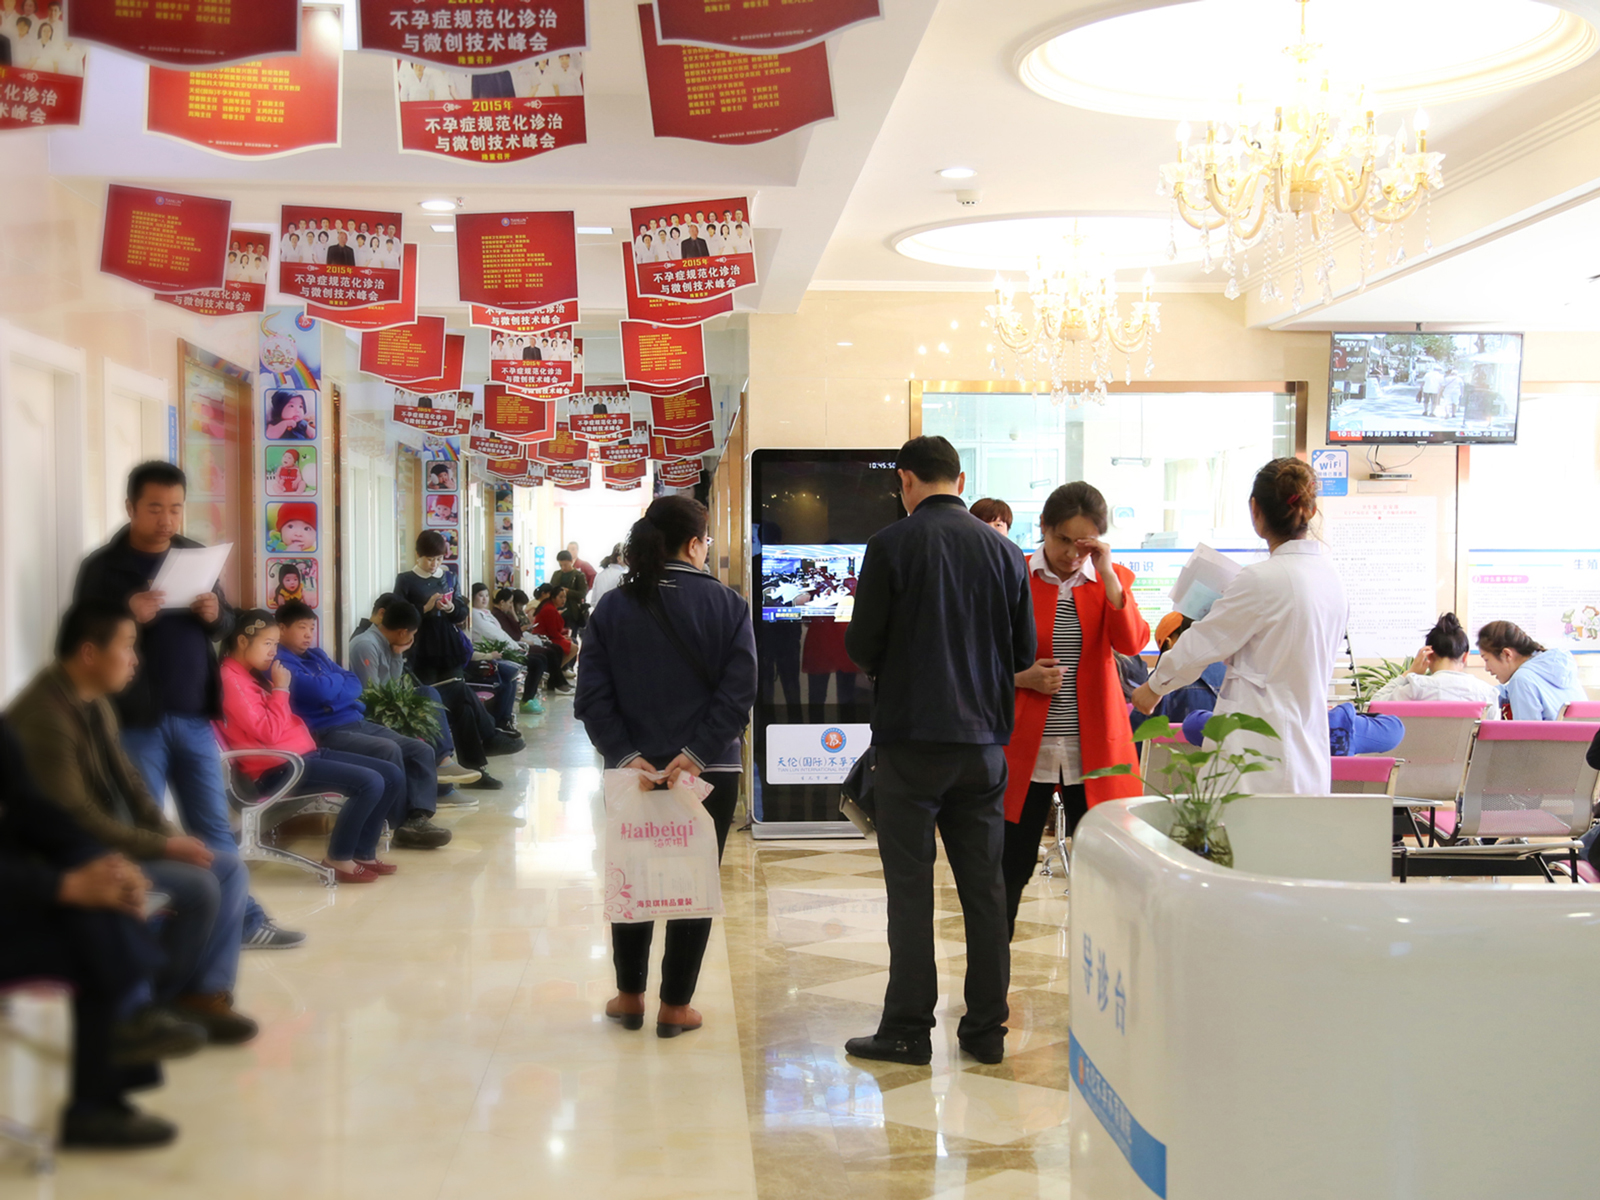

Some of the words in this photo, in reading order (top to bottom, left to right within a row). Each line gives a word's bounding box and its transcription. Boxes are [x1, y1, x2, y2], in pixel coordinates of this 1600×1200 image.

[389, 9, 558, 30] 不孕症规范化诊治
[402, 32, 548, 53] 与微创技术峰会
[0, 83, 58, 107] 化诊治
[472, 100, 513, 112] 2015年
[425, 113, 563, 133] 不孕症规范化诊治
[435, 133, 556, 152] 与微创技术峰会
[326, 265, 353, 274] 2015年
[682, 258, 708, 267] 2015年
[294, 274, 385, 290] 不孕症规范化诊治
[653, 265, 740, 283] 不孕症规范化诊治
[300, 286, 379, 302] 与微创技术峰会
[660, 278, 736, 294] 与微创技术峰会
[174, 295, 246, 312] 与微创技术峰会
[491, 315, 560, 326] 与微创技术峰会
[501, 367, 562, 375] 不孕症规范化诊治
[621, 820, 694, 848] Haibeiqi
[1083, 932, 1126, 1036] 导诊台
